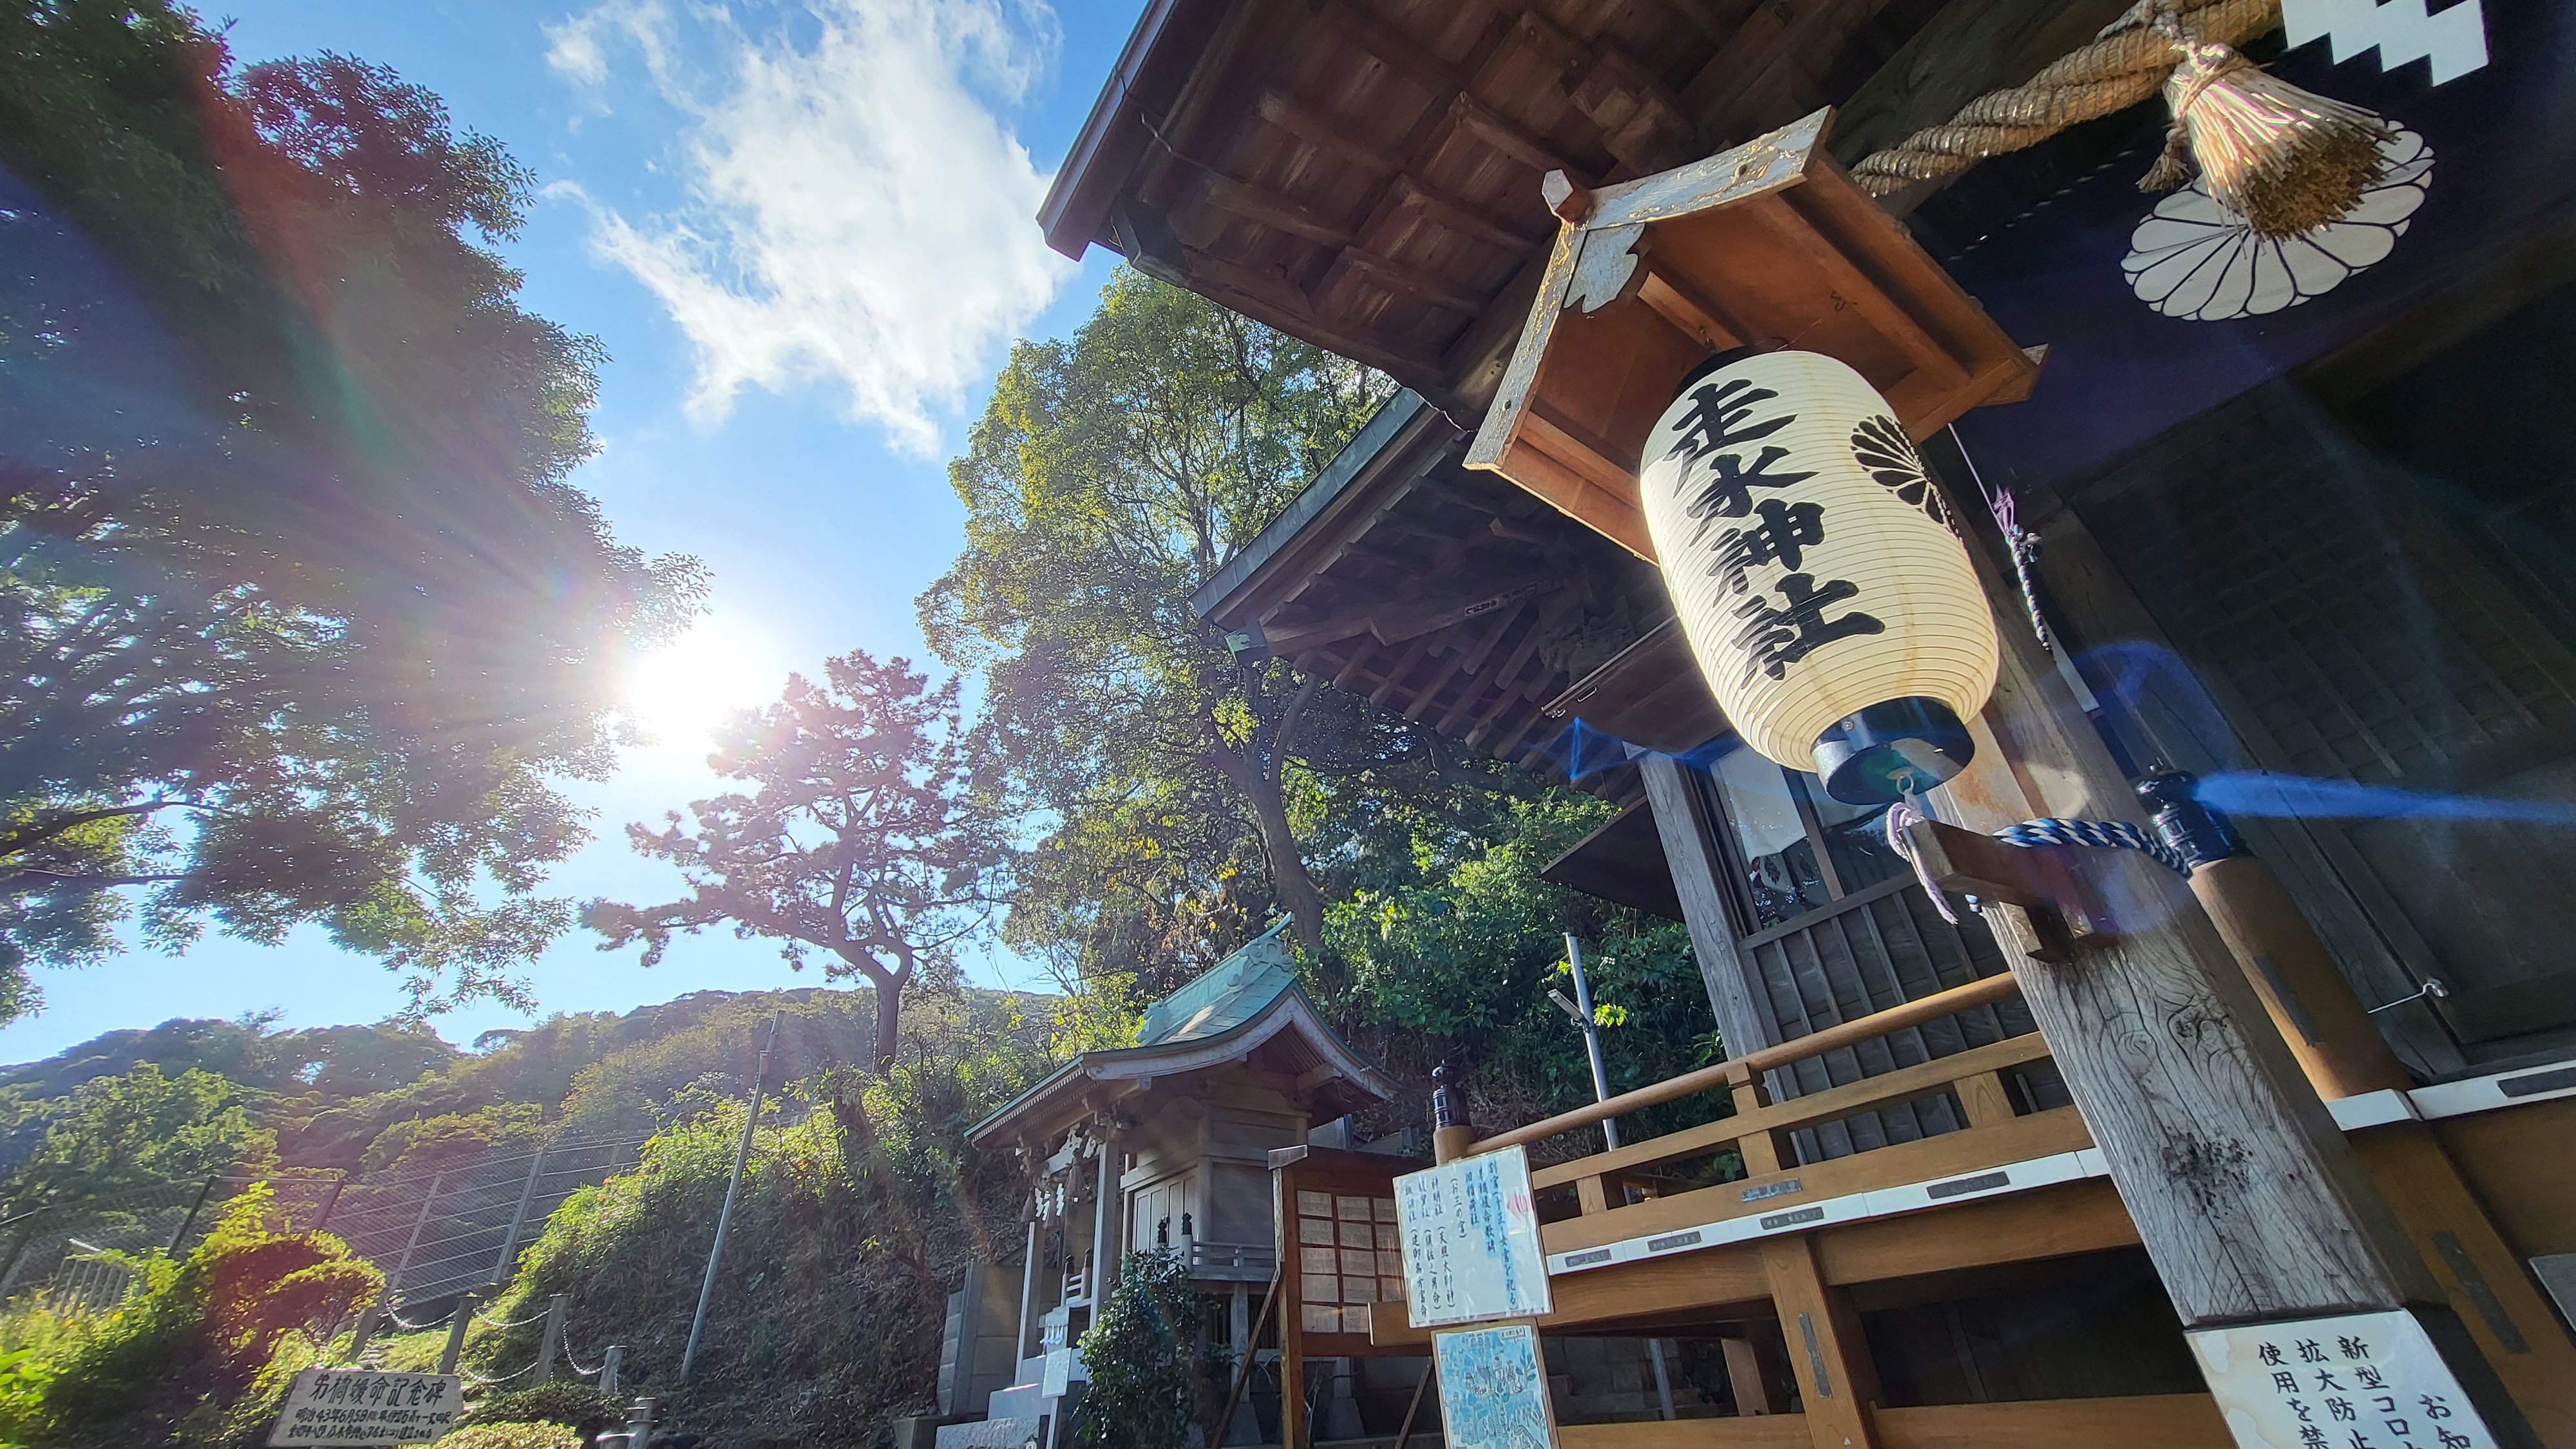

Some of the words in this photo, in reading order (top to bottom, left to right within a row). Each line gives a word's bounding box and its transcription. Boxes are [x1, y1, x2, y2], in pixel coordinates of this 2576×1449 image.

[1662, 379, 1885, 688] 走水神社
[309, 1373, 446, 1407] 弟橘媛命記念碑
[2295, 1338, 2377, 1449] 拡大防止
[2338, 1336, 2421, 1449] 新型コロ
